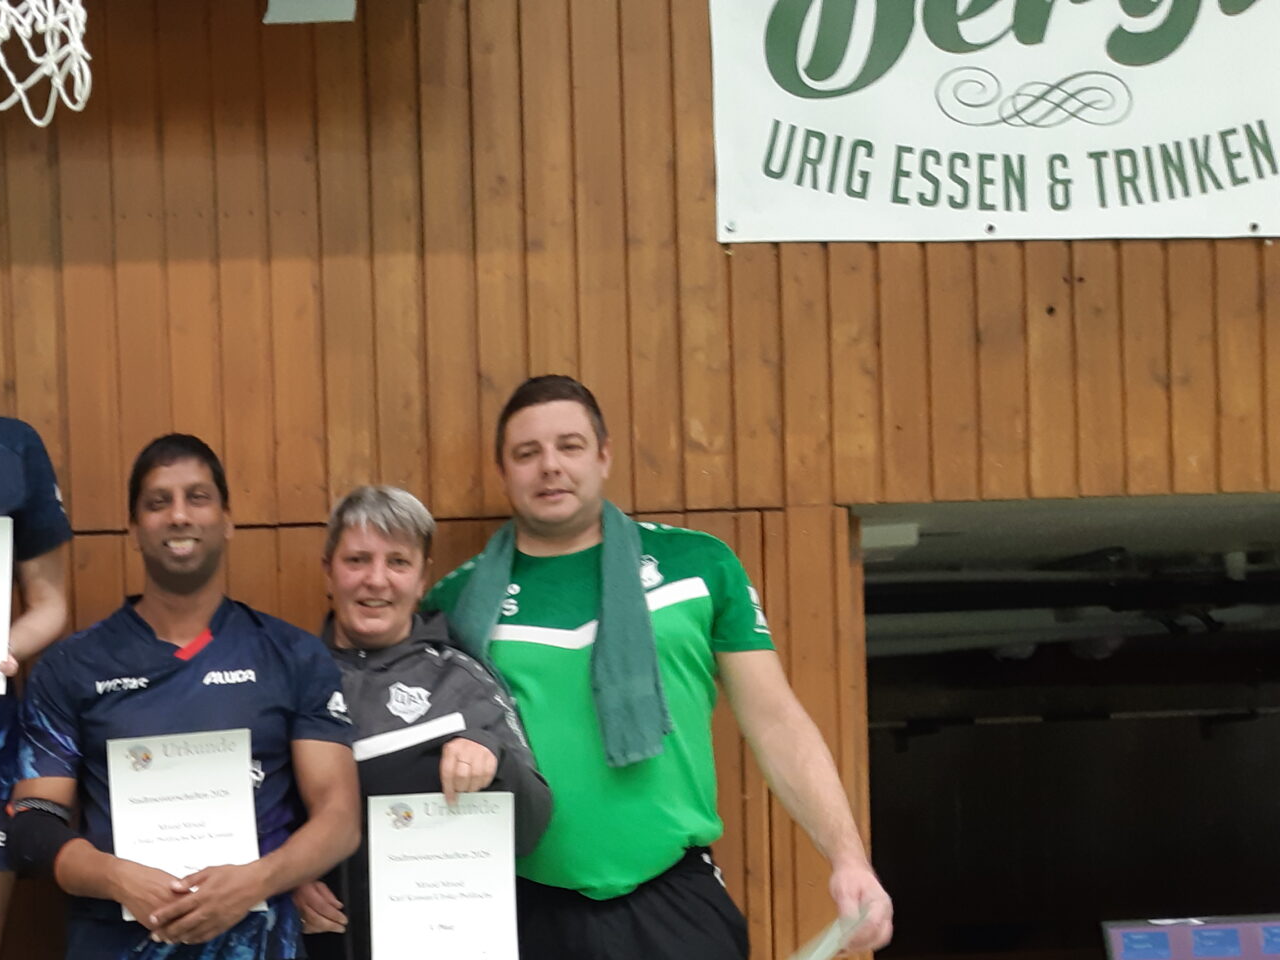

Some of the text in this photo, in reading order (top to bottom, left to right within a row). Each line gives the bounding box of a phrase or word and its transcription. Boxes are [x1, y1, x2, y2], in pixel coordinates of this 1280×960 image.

[763, 118, 1280, 211] URIG ESSEN & TRINKEN
